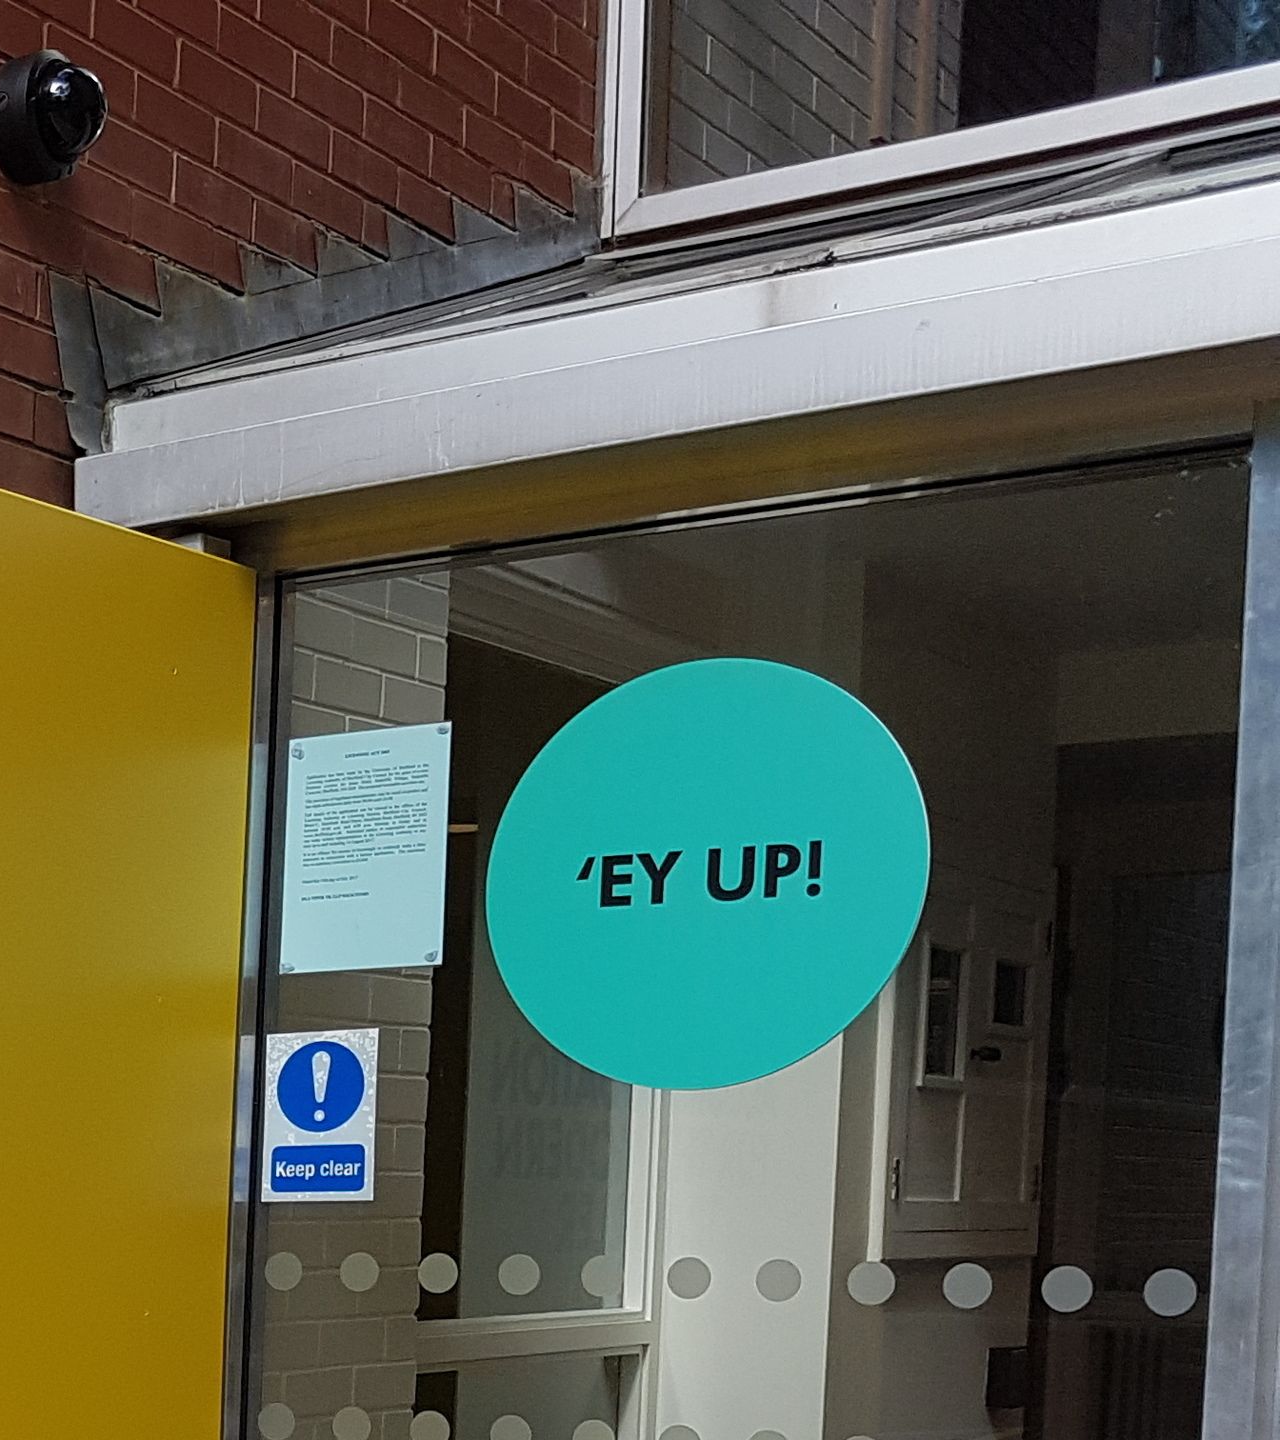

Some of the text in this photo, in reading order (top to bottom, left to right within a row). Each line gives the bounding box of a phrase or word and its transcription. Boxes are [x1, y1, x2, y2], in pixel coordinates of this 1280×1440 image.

[706, 839, 823, 902] UP!
[275, 1160, 361, 1180] Keep clear
